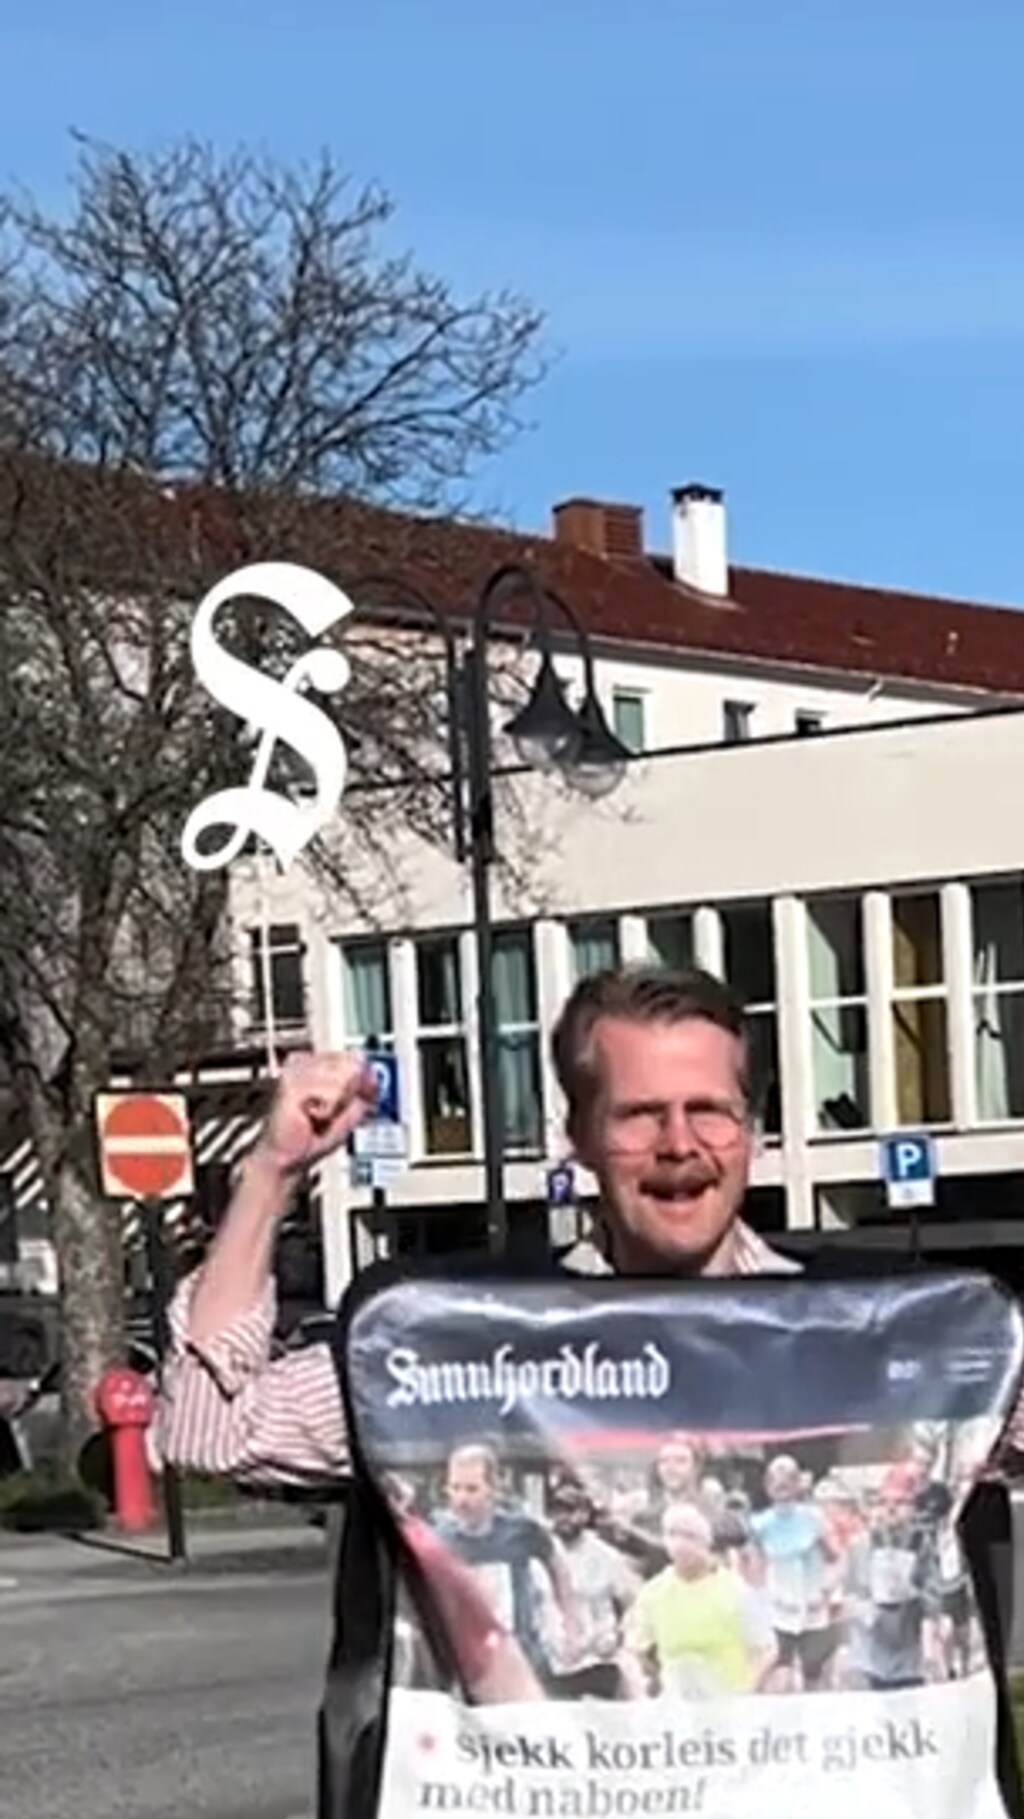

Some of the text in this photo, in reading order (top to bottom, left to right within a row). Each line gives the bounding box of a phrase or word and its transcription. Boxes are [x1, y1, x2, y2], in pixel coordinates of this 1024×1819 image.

[898, 1142, 923, 1178] P
[386, 1341, 671, 1416] Sunnhordland
[455, 1719, 939, 1774] Sjekk korleis det gjekk
[417, 1776, 516, 1816] med
